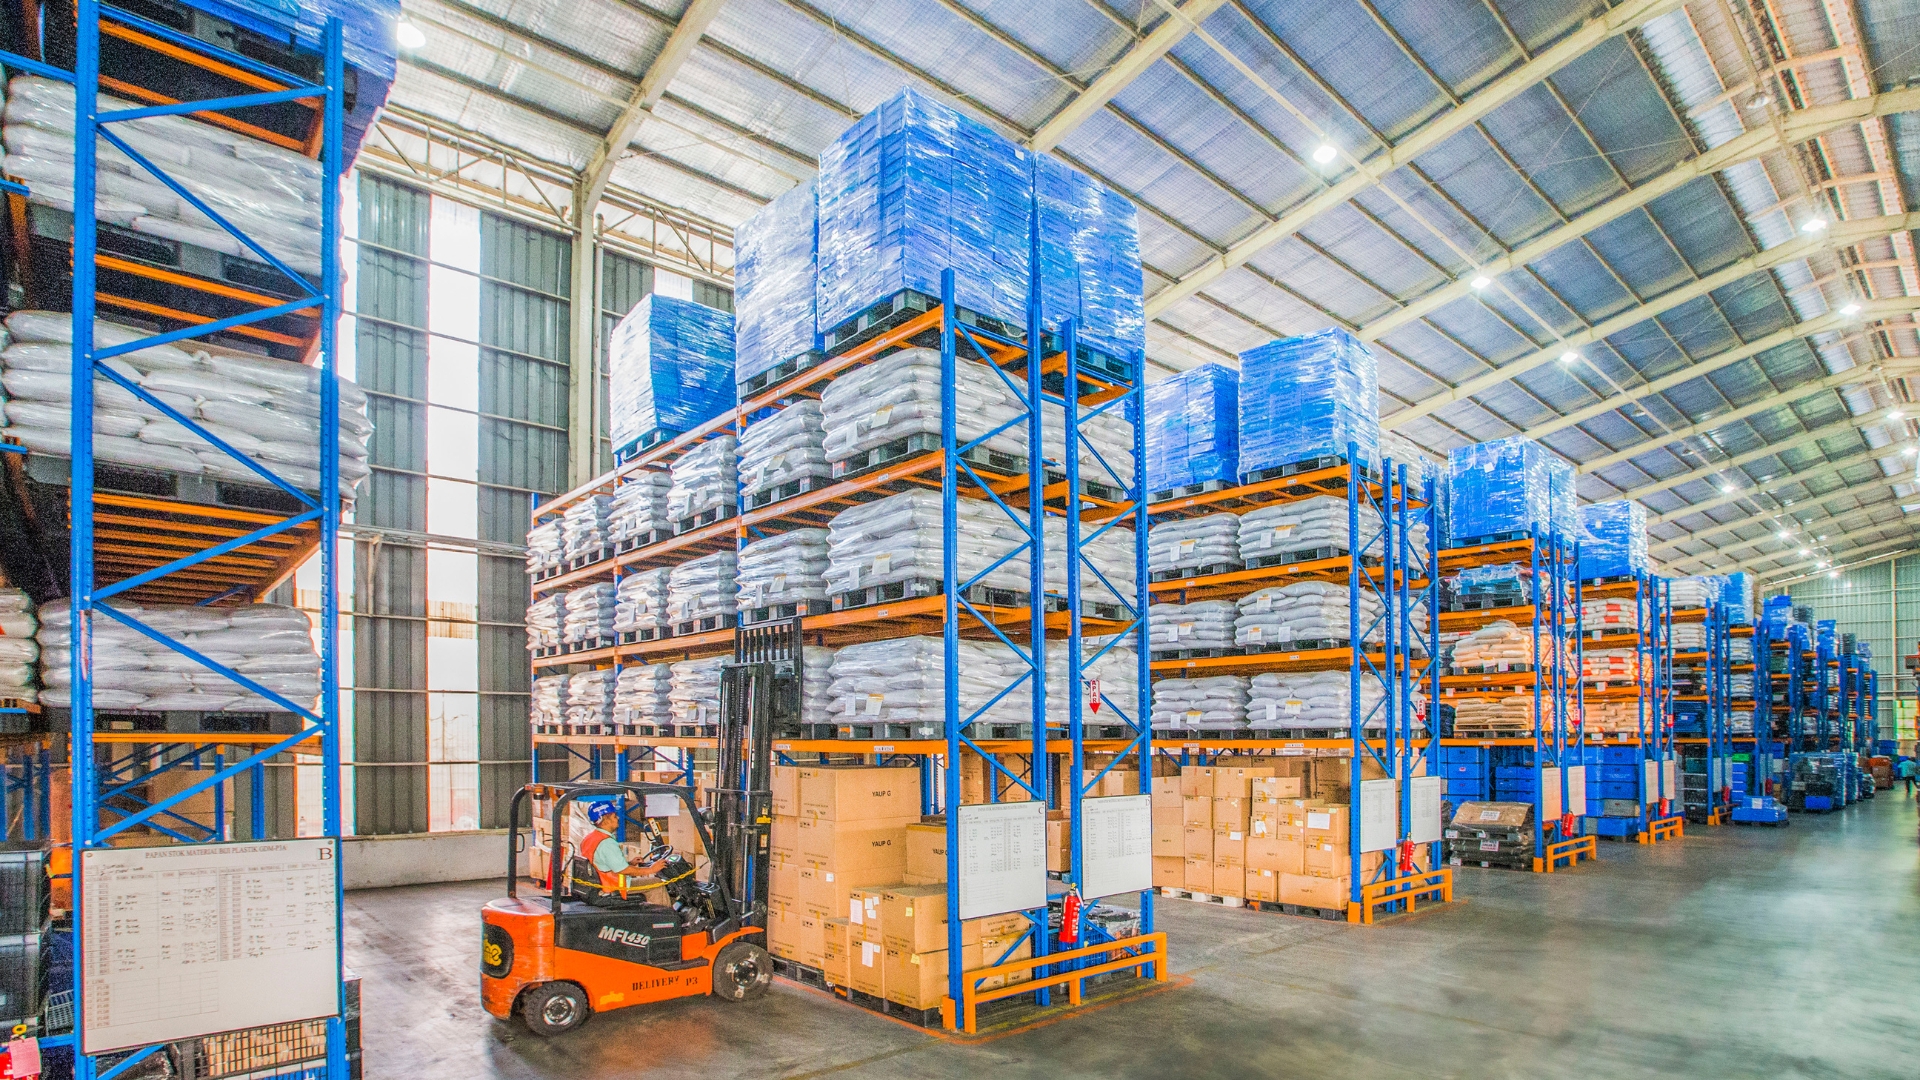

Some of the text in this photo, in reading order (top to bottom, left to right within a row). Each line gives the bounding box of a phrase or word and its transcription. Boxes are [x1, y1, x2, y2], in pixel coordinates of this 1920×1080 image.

[1038, 806, 1044, 814] C
[186, 848, 217, 857] MATERIAL
[232, 846, 258, 854] PLASTIK
[319, 847, 333, 860] B
[632, 975, 698, 991] DELIVERY P3
